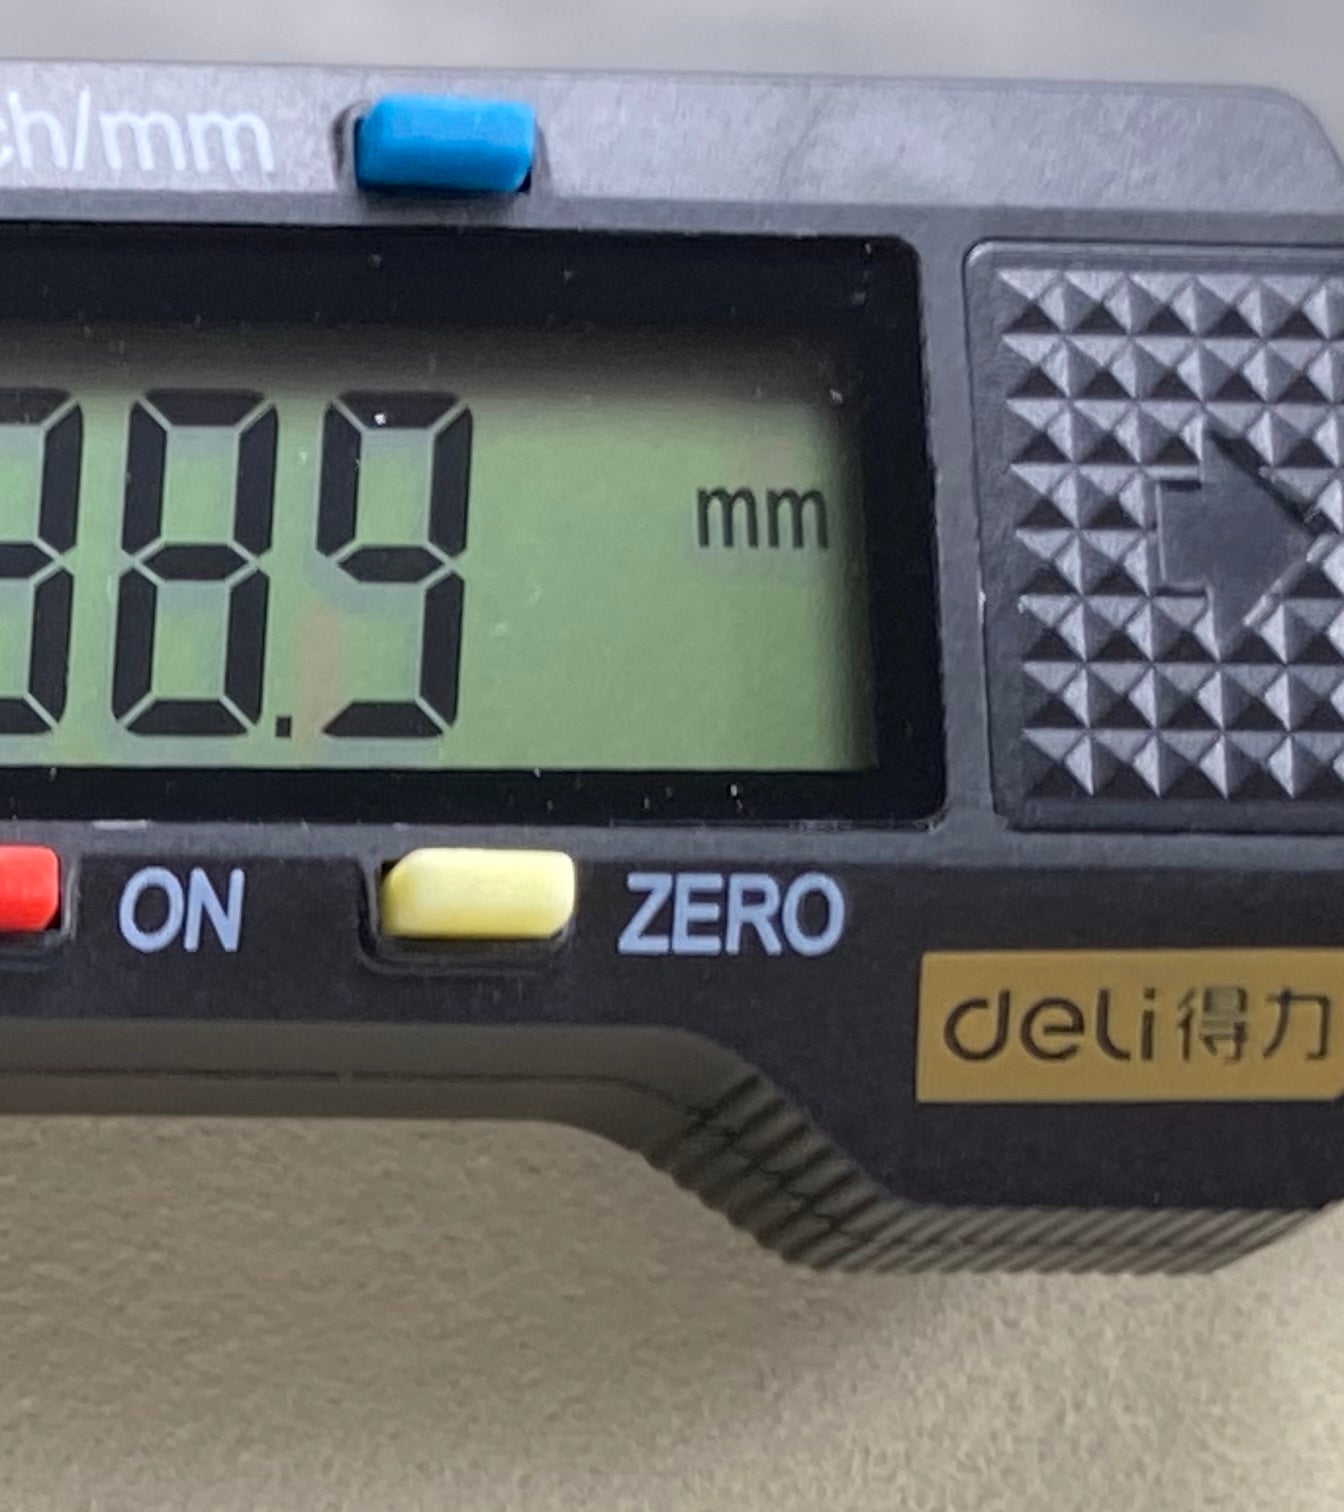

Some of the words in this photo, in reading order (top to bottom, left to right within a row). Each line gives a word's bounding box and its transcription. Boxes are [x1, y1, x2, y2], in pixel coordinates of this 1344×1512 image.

[698, 486, 830, 552] mm
[118, 866, 245, 952] ON
[618, 872, 846, 954] ZERO
[944, 986, 1156, 1062] deli
[1176, 986, 1332, 1064] 得力
